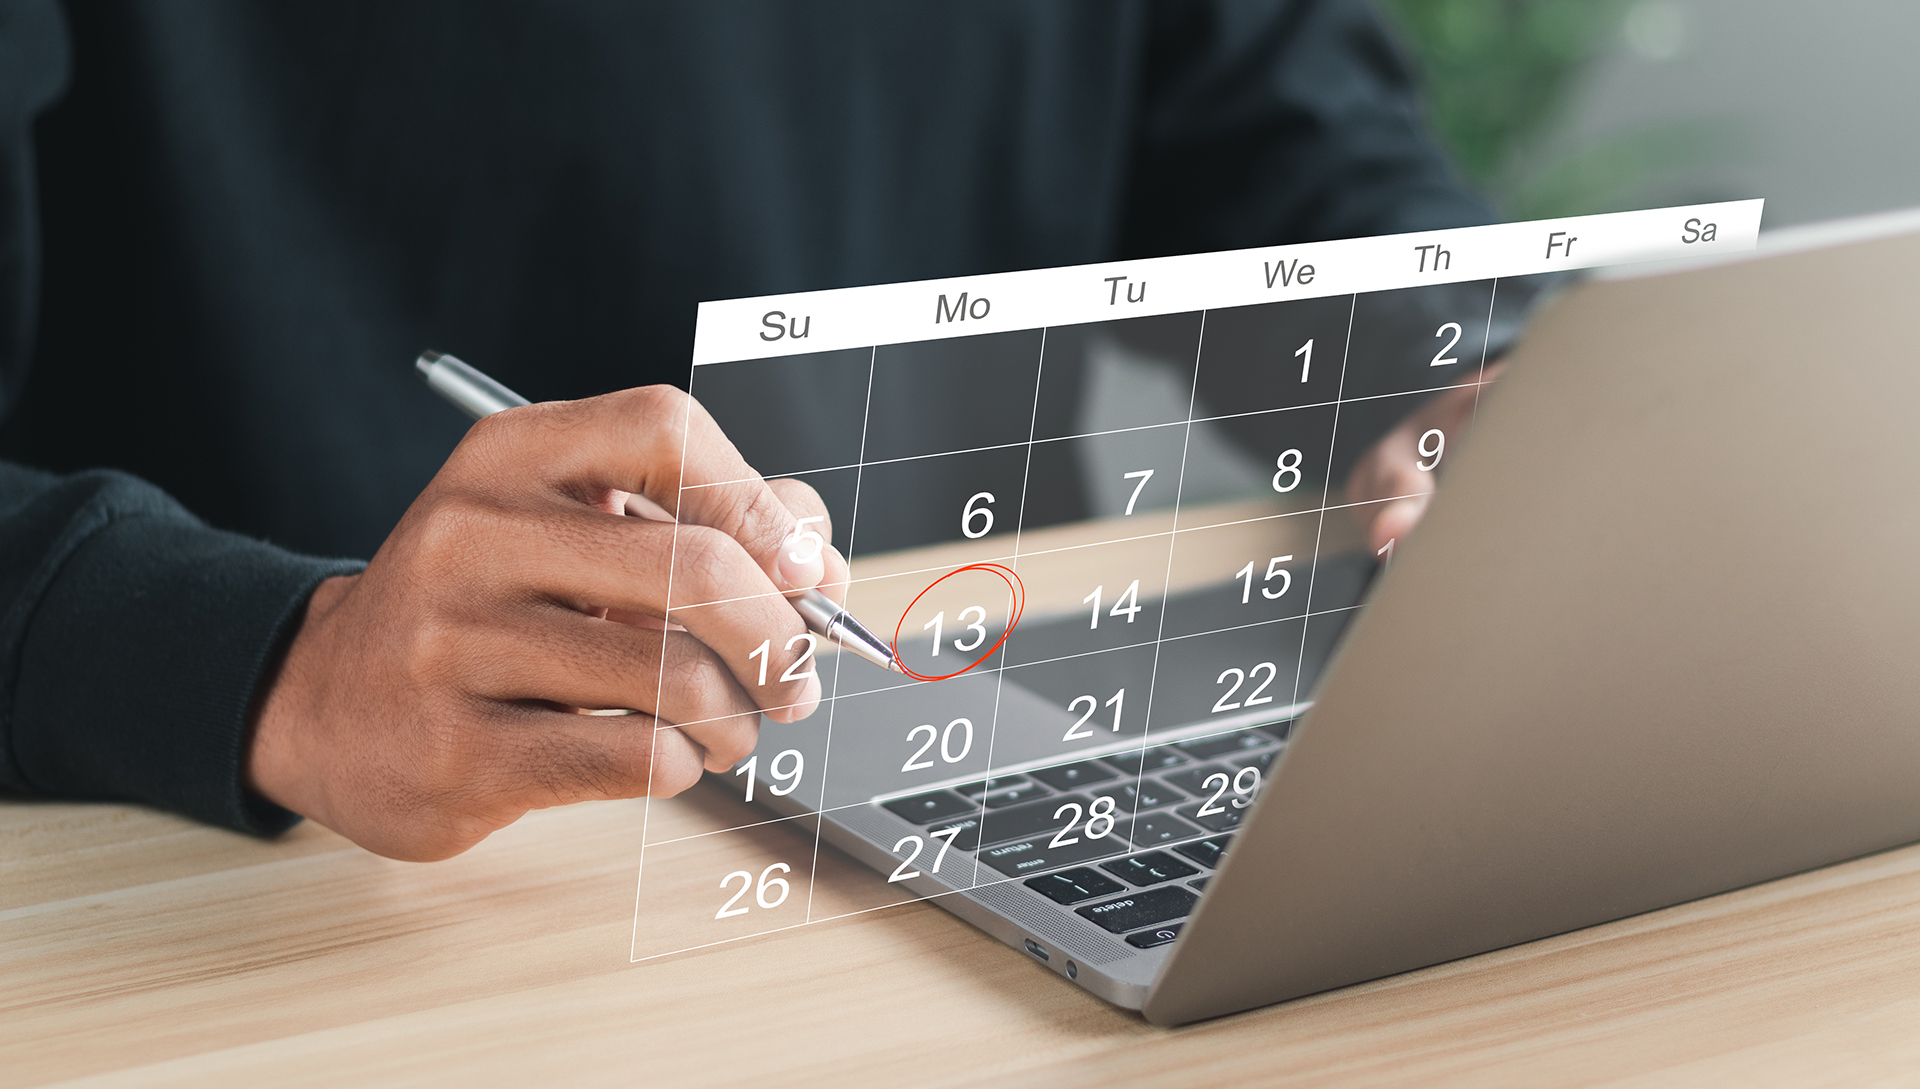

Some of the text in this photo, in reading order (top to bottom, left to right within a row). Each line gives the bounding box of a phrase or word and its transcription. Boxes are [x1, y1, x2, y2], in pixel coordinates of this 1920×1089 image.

[990, 842, 1034, 856] return
[1016, 858, 1046, 869] enter
[1092, 899, 1135, 913] delete
